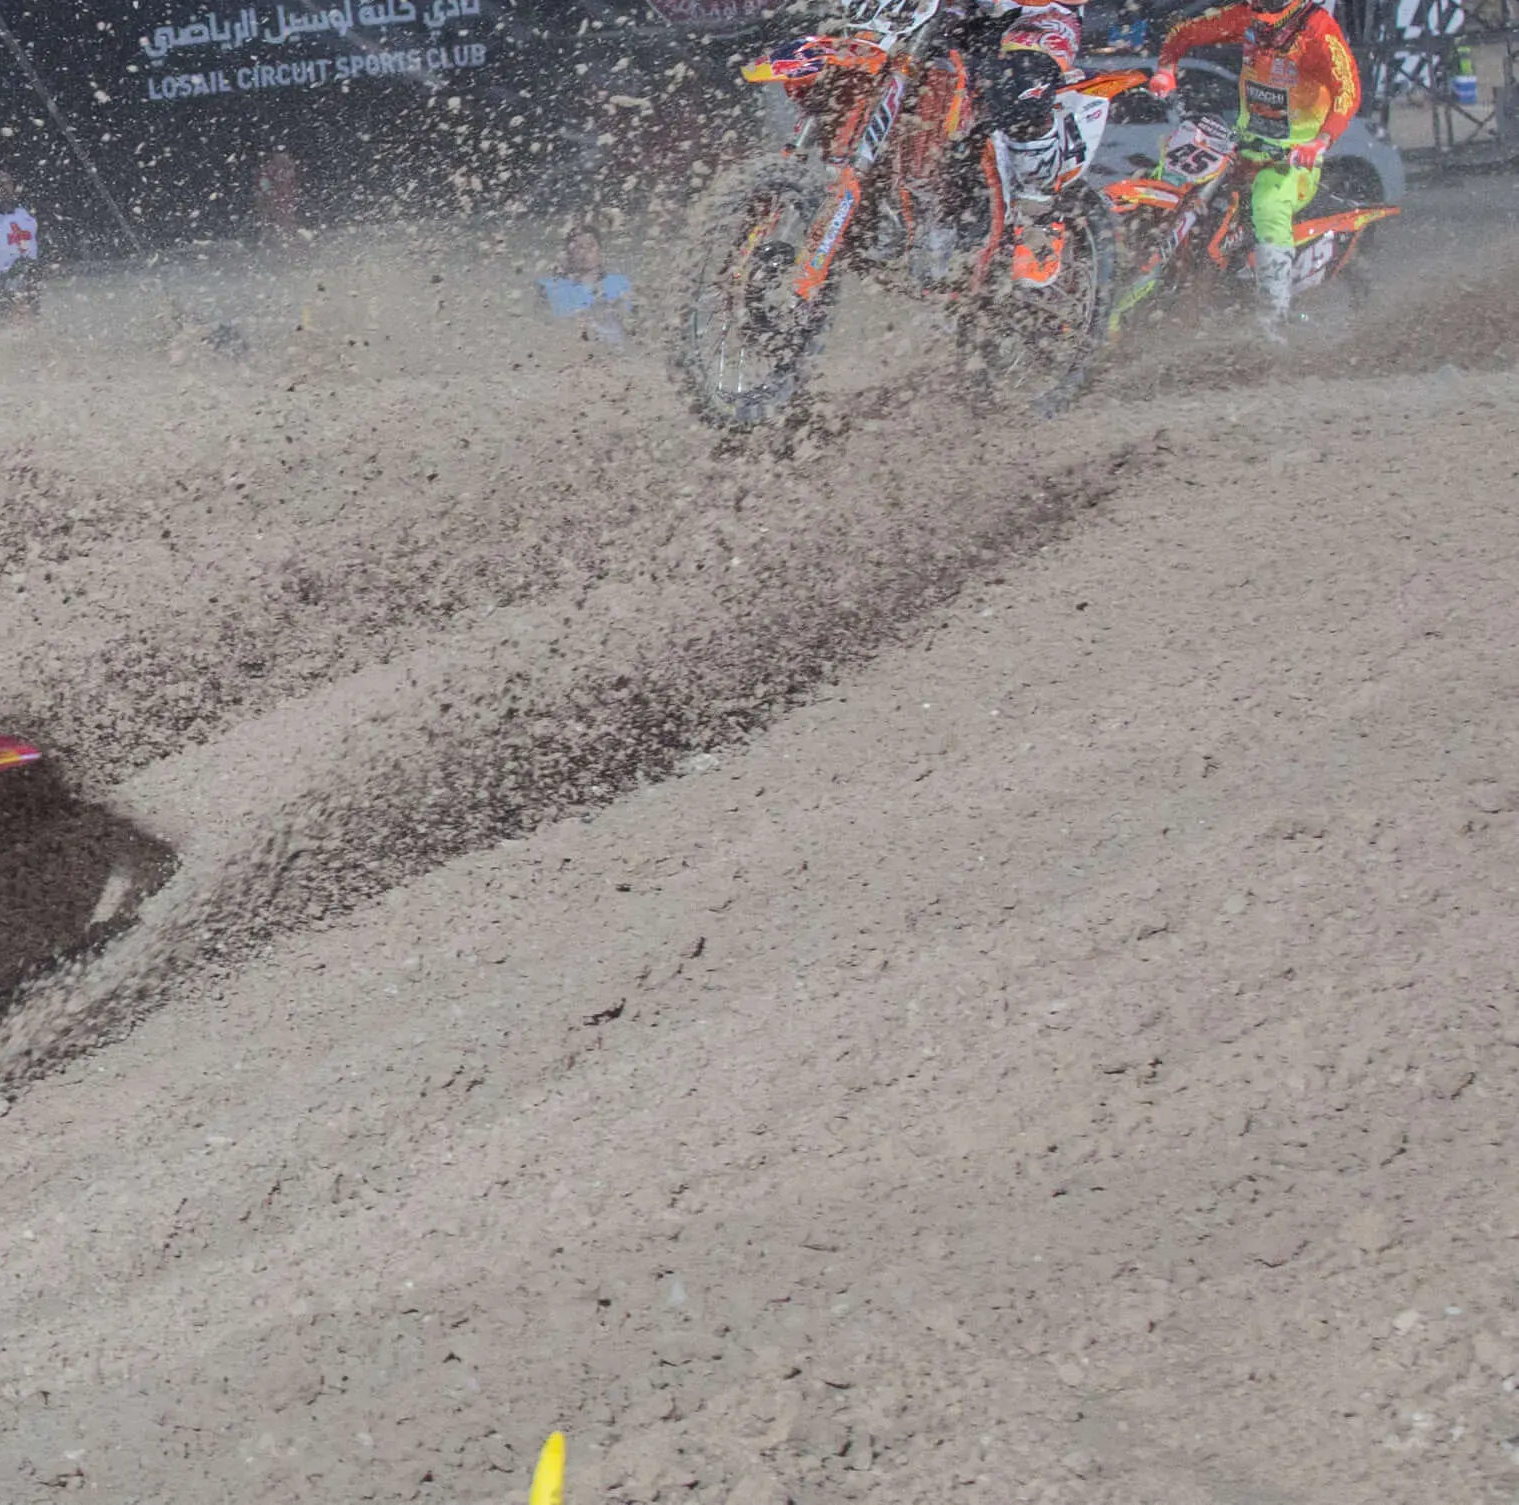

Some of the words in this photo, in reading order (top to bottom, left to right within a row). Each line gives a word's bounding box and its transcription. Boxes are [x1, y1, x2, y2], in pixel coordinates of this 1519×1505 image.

[147, 71, 233, 100] LOSAIL
[237, 58, 329, 91] CIRCUIT
[336, 48, 422, 81] SPORTS
[425, 42, 488, 71] CLUB
